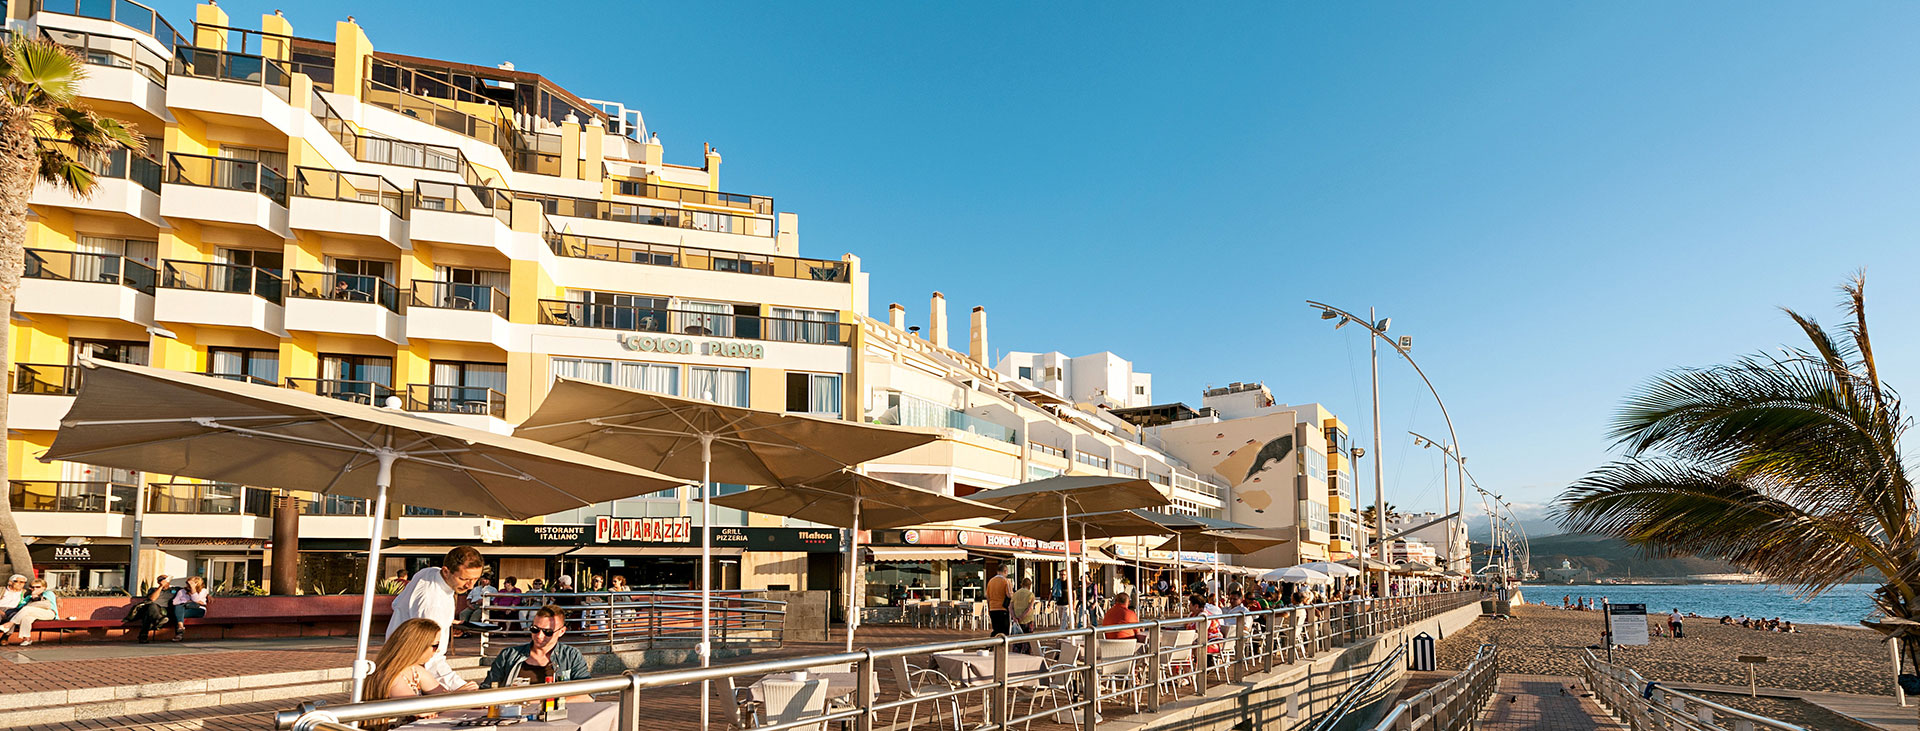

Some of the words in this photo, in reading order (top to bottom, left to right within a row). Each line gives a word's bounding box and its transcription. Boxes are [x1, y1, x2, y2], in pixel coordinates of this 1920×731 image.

[626, 335, 693, 354] COLON
[708, 341, 765, 359] PLAYA
[534, 526, 584, 534] RISTORANTE
[597, 518, 690, 539] PAPARAZZI
[799, 531, 833, 540] Mahou
[987, 535, 1010, 546] HOME
[1010, 537, 1020, 547] OF
[1021, 538, 1037, 548] THE
[54, 547, 91, 557] NARA
